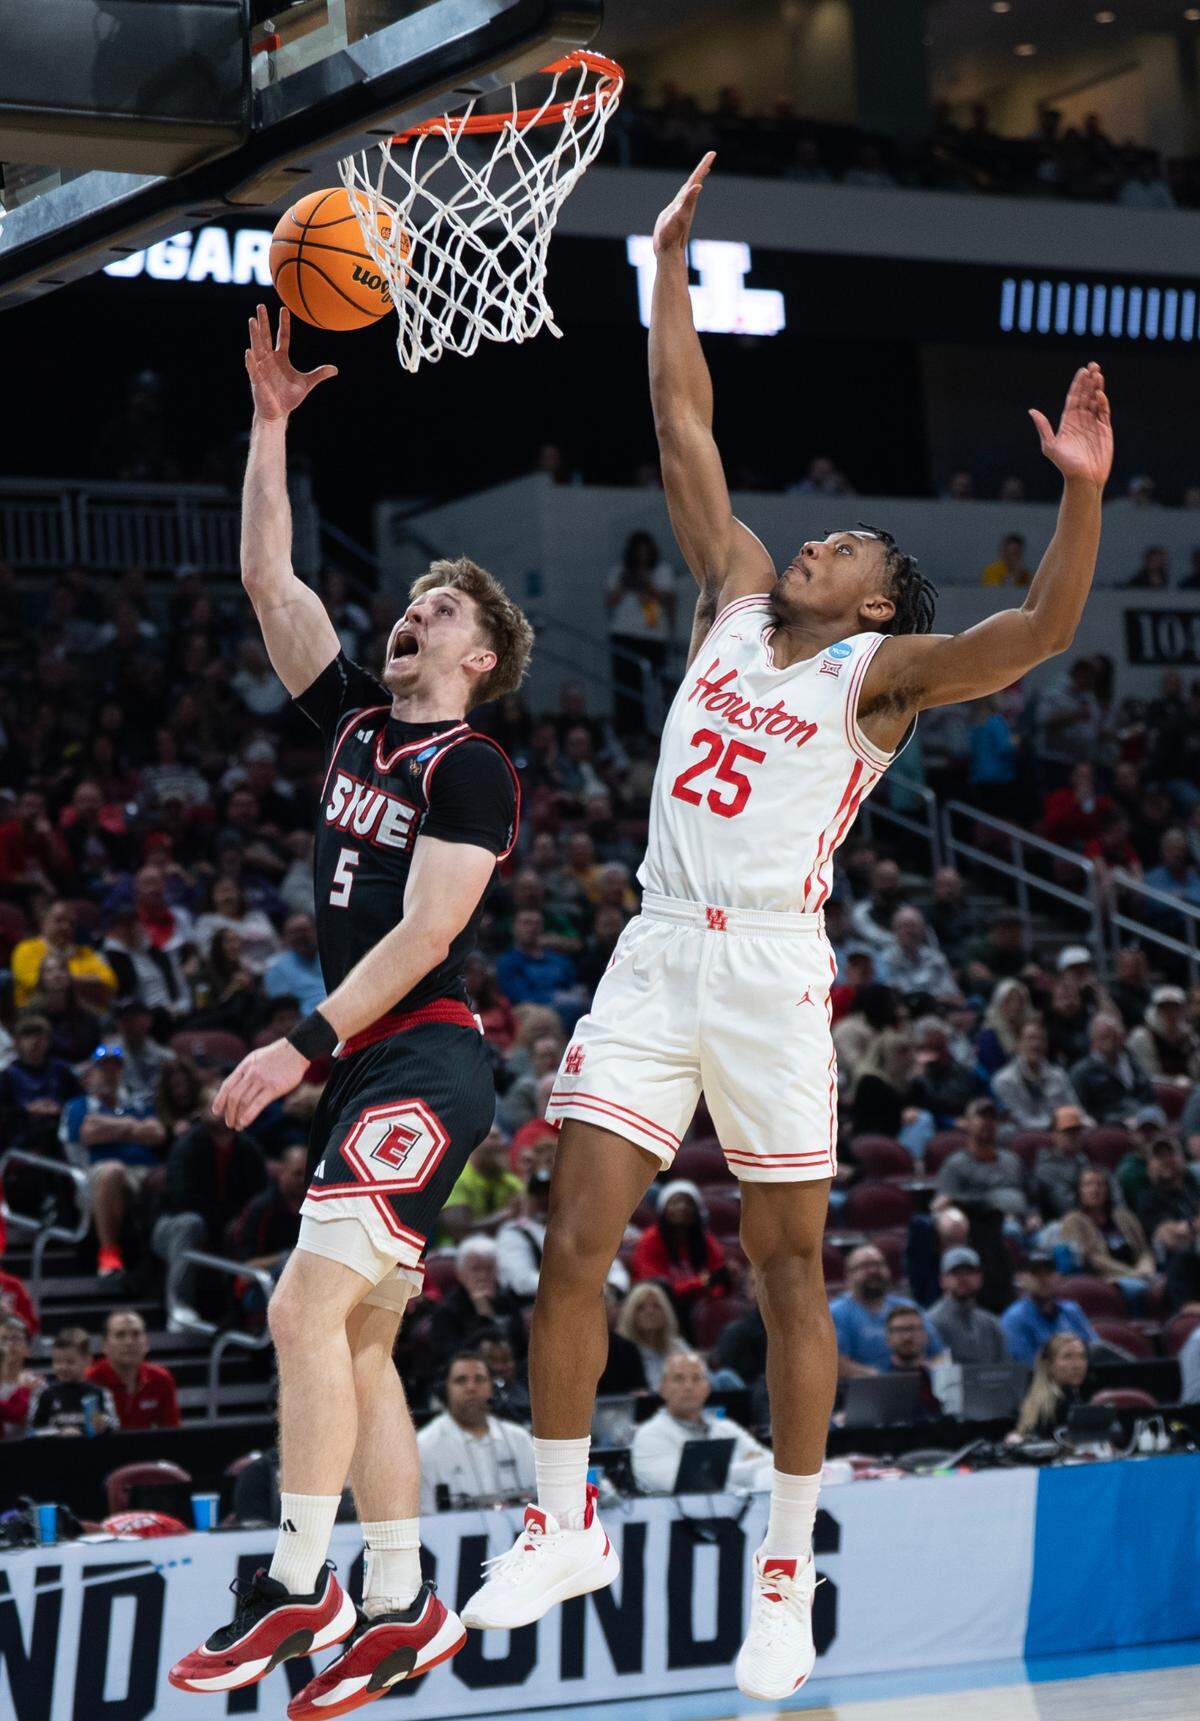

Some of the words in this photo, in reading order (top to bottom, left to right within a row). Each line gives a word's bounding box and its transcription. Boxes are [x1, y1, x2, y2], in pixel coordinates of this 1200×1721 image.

[352, 263, 393, 304] lson
[1139, 613, 1200, 658] 10
[688, 656, 819, 748] Houston
[671, 728, 767, 818] 25
[325, 772, 418, 850] SIUE
[329, 847, 360, 909] 5
[370, 1123, 423, 1171] E
